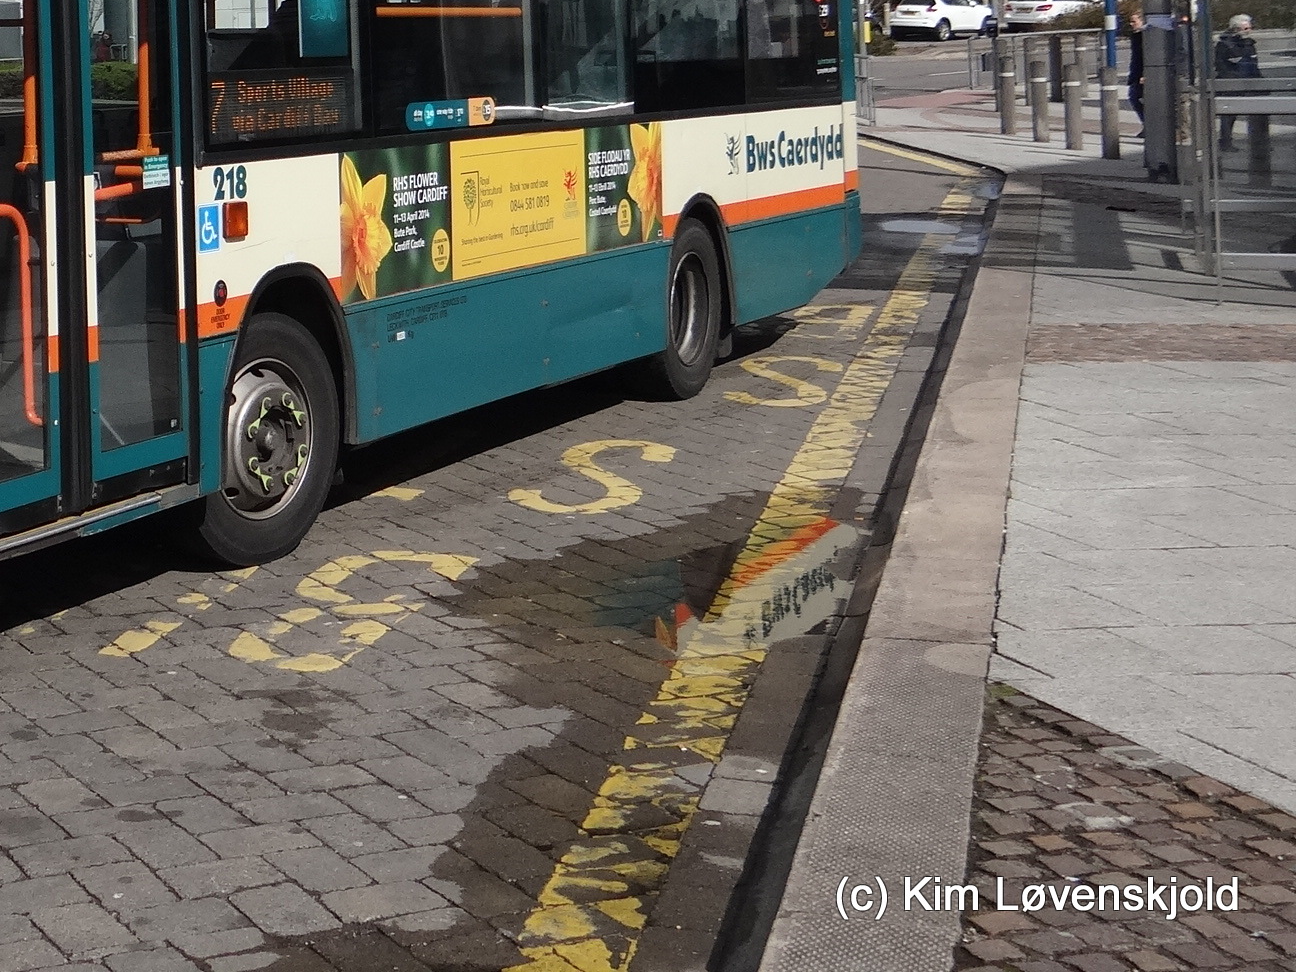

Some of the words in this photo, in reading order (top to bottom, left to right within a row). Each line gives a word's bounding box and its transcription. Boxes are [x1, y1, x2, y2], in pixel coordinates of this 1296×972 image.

[237, 80, 285, 105] Sports
[288, 77, 334, 101] Village
[211, 81, 226, 134] 7
[232, 109, 254, 132] via
[257, 106, 309, 130] Cardiff
[746, 134, 776, 173] Bws
[777, 123, 844, 170] Caerdydd
[602, 150, 623, 164] FLODAU
[588, 166, 600, 179] RHS
[600, 162, 629, 178] CAERDYDD
[213, 164, 248, 201] 218
[393, 175, 408, 192] RHS
[409, 171, 438, 189] FLOWER
[480, 176, 490, 187] Royal
[510, 182, 521, 193] Book
[522, 183, 530, 191] now
[529, 179, 539, 189] and
[539, 180, 549, 188] save
[393, 189, 416, 208] SHOW
[417, 186, 448, 204] CARDIFF
[480, 185, 503, 197] Horticultural
[480, 198, 494, 208] Society
[510, 199, 525, 212] 0844
[525, 197, 535, 210] 581
[536, 194, 550, 208] 0819
[407, 210, 418, 223] April
[418, 208, 430, 220] 2014
[393, 227, 405, 238] Bute
[510, 216, 555, 237] rhs.org.uk/cardiff
[394, 239, 411, 252] Cardiff
[411, 238, 425, 249] Castle
[437, 244, 444, 255] 10
